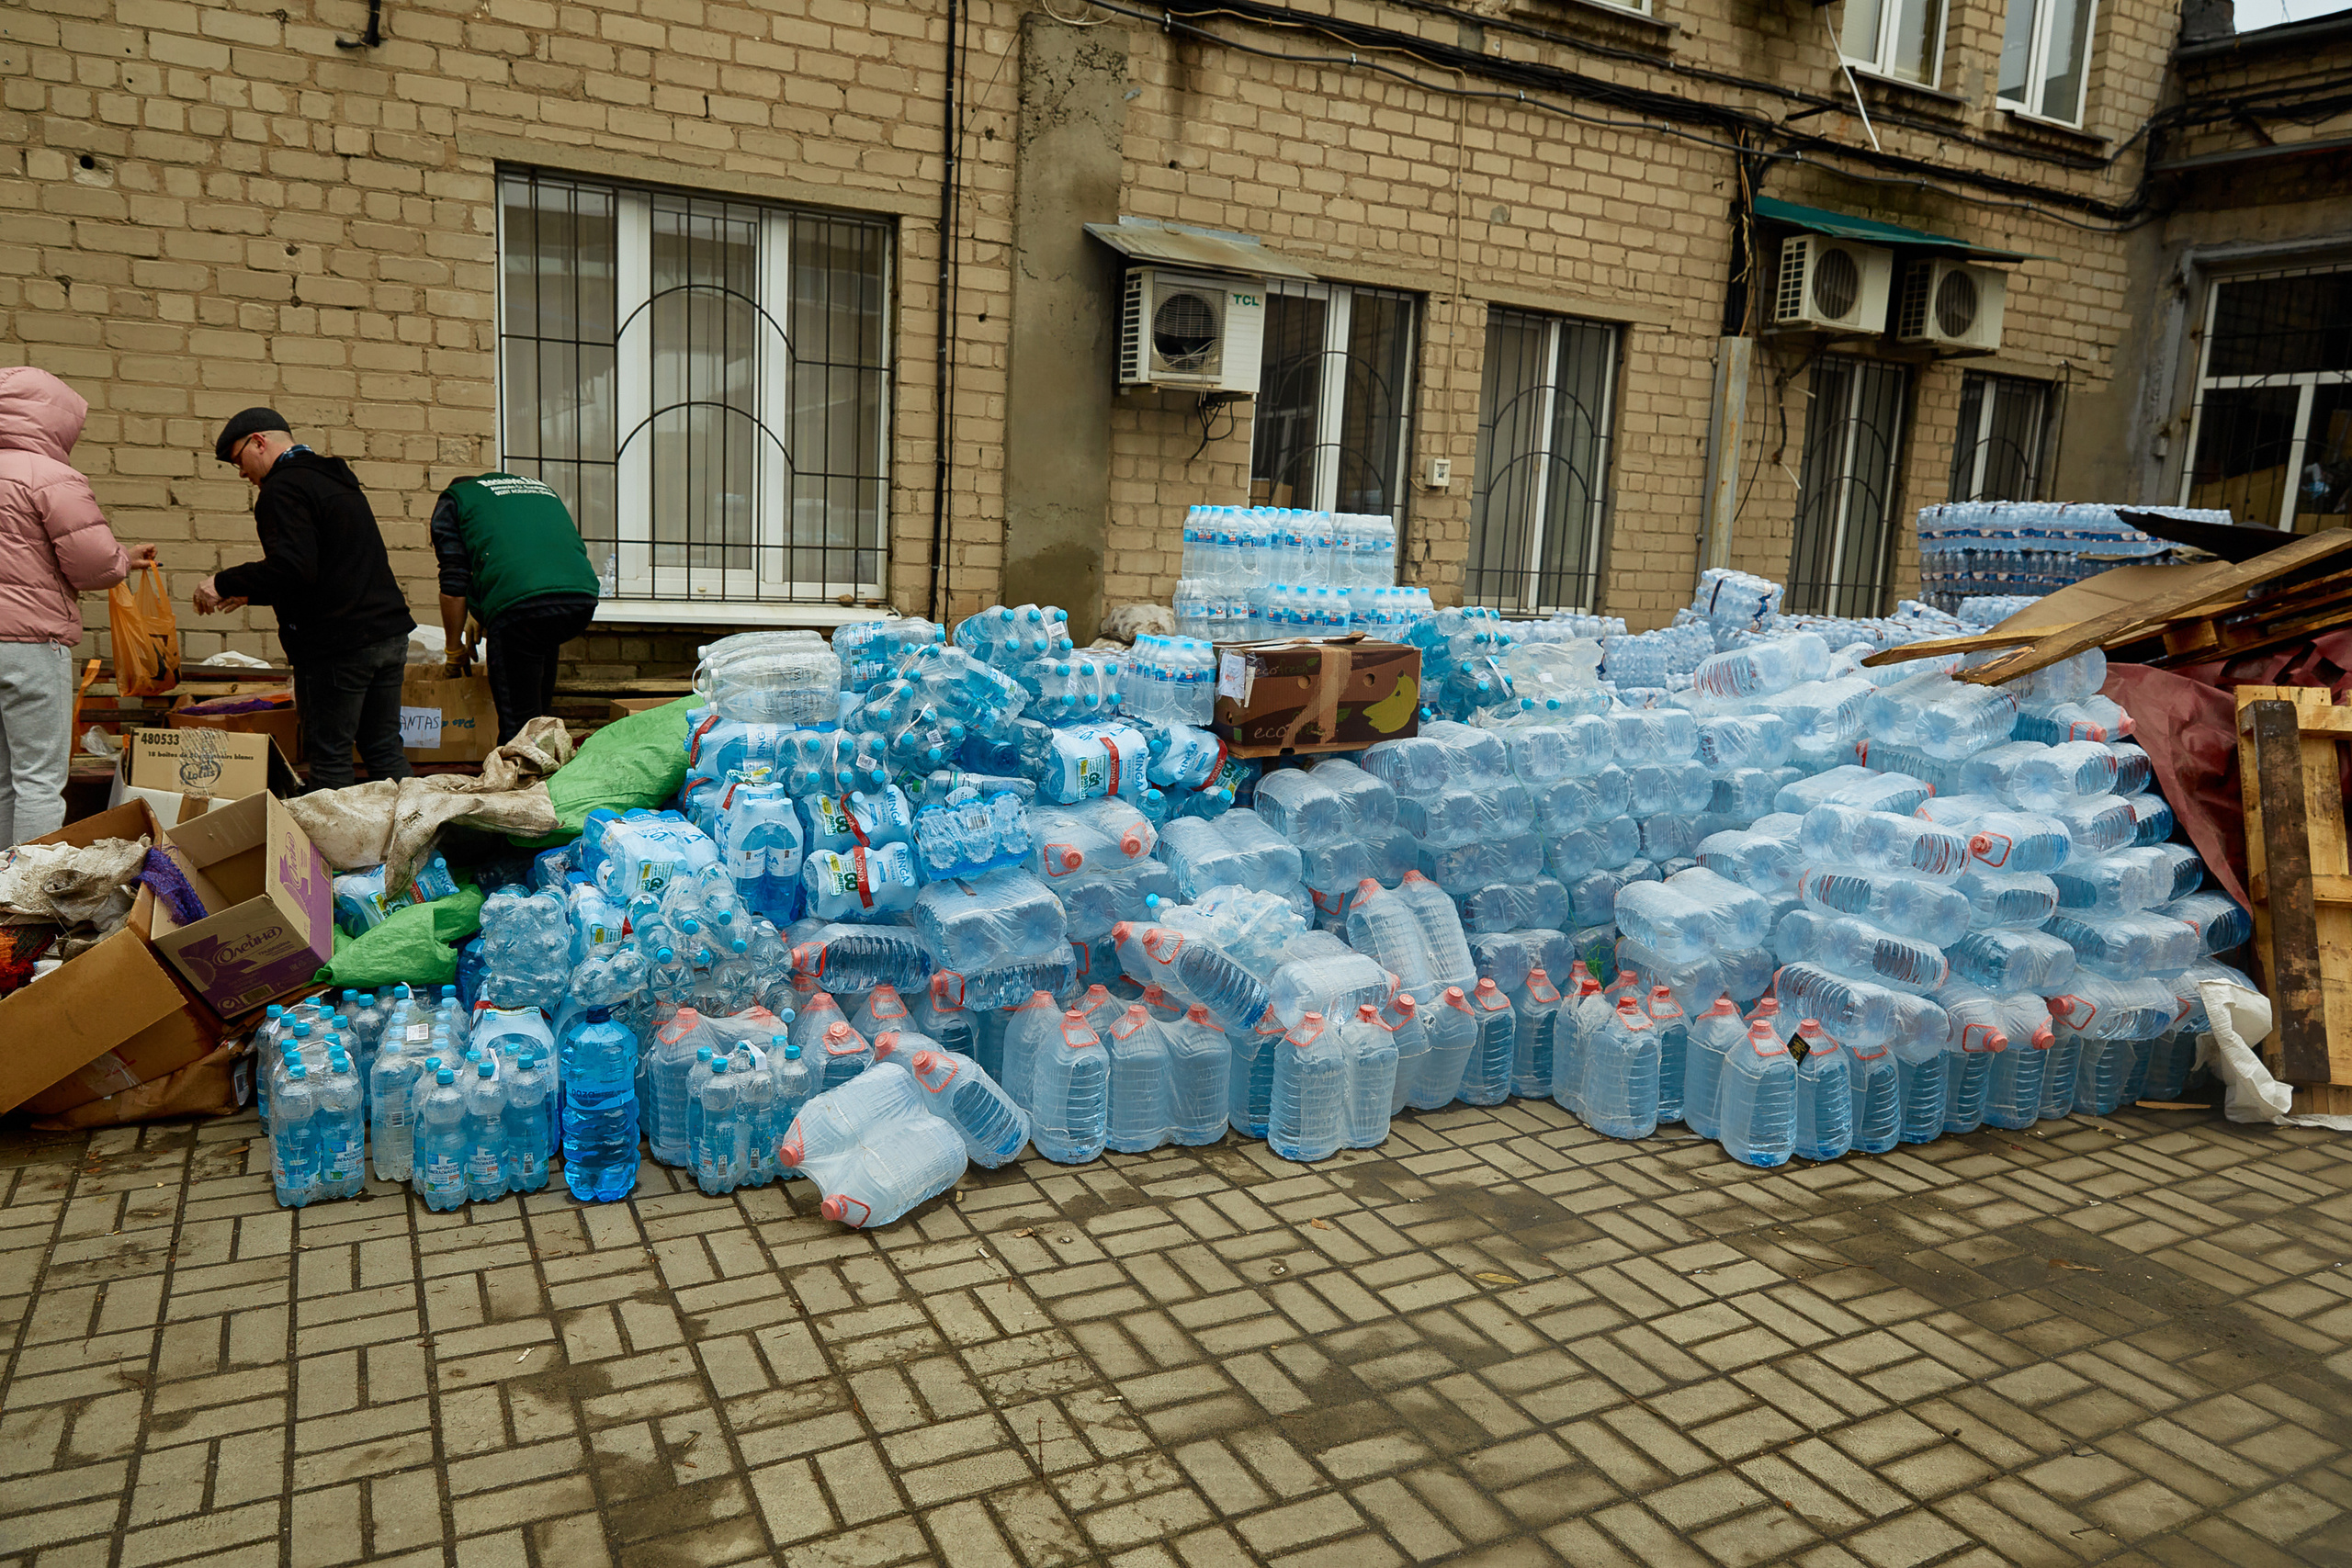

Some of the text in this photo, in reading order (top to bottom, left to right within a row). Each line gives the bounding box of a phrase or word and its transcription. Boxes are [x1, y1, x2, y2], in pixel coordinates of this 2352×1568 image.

[1233, 294, 1260, 306] TCL
[401, 716, 440, 730] ANTAS
[141, 732, 180, 745] 480533
[187, 769, 216, 781] Lotus
[1136, 752, 1147, 788] KINGA
[1209, 758, 1225, 782] KINGA
[888, 791, 903, 826] KINGA
[835, 815, 852, 834] GO
[855, 854, 865, 883] KINGA
[896, 848, 910, 884] KINGA
[843, 872, 859, 891] GO
[218, 927, 277, 962] Олейна
